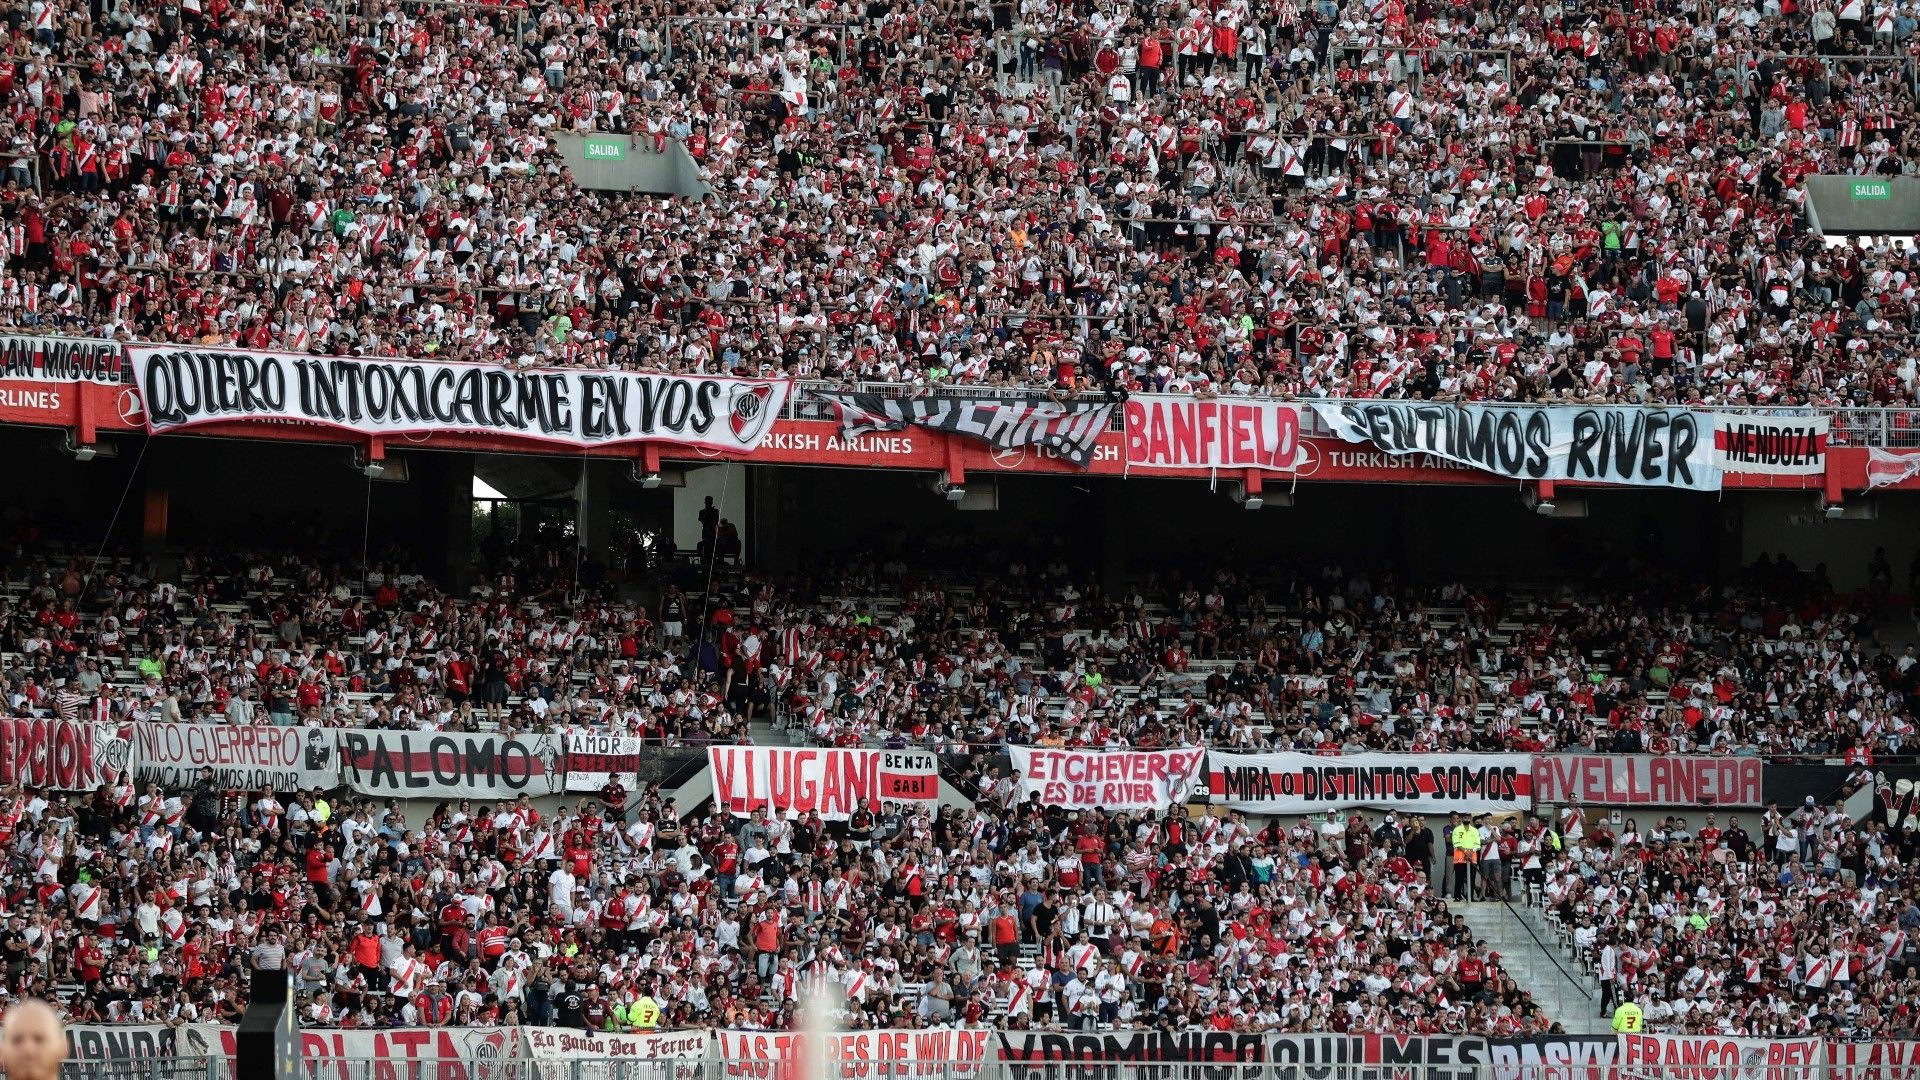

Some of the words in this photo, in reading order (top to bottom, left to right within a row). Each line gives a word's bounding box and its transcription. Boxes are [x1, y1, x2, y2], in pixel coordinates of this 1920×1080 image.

[589, 144, 619, 157] SALIDA
[1855, 184, 1886, 196] SALIDA
[0, 339, 35, 378] AN
[43, 341, 119, 382] MIGUEL
[144, 351, 287, 428] QUIERO
[293, 358, 574, 435] INTOXICARME
[579, 373, 631, 441] EN
[636, 376, 721, 436] VOS
[761, 433, 819, 451] RKISH
[826, 436, 912, 454] AIRLINES
[1124, 401, 1299, 468] BANFIELD
[1566, 409, 1697, 485] RIVER
[1726, 423, 1819, 466] MENDOZA
[1329, 451, 1414, 469] TURKISH
[136, 723, 184, 762] NICO
[188, 725, 300, 766] GUERRERO
[346, 733, 531, 789] PALOMO
[573, 735, 621, 755] AMOR
[885, 753, 932, 769] BENJA
[137, 766, 180, 787] NUNCA
[212, 769, 244, 790] AMOS
[245, 769, 252, 789] A
[255, 769, 299, 792] OLVIDAR
[1028, 748, 1205, 783] ETCHEVERRY
[1532, 757, 1761, 805] AVELLANEDA
[1043, 782, 1067, 804] ES
[1073, 783, 1096, 804] DE
[1103, 782, 1157, 804] RIVER
[1223, 766, 1275, 801] MIRA
[1302, 766, 1420, 801] DISTINTOS
[1431, 766, 1517, 801] SOMOS
[643, 1010, 654, 1024] 3
[1626, 1017, 1636, 1029] 3
[531, 1030, 555, 1049] La
[559, 1034, 605, 1053] Banda
[720, 1033, 769, 1079] LAS
[878, 1033, 908, 1076] DE
[1272, 1036, 1484, 1080] QUILMES
[1626, 1034, 1740, 1080] FRANCO
[1767, 1040, 1819, 1080] REY
